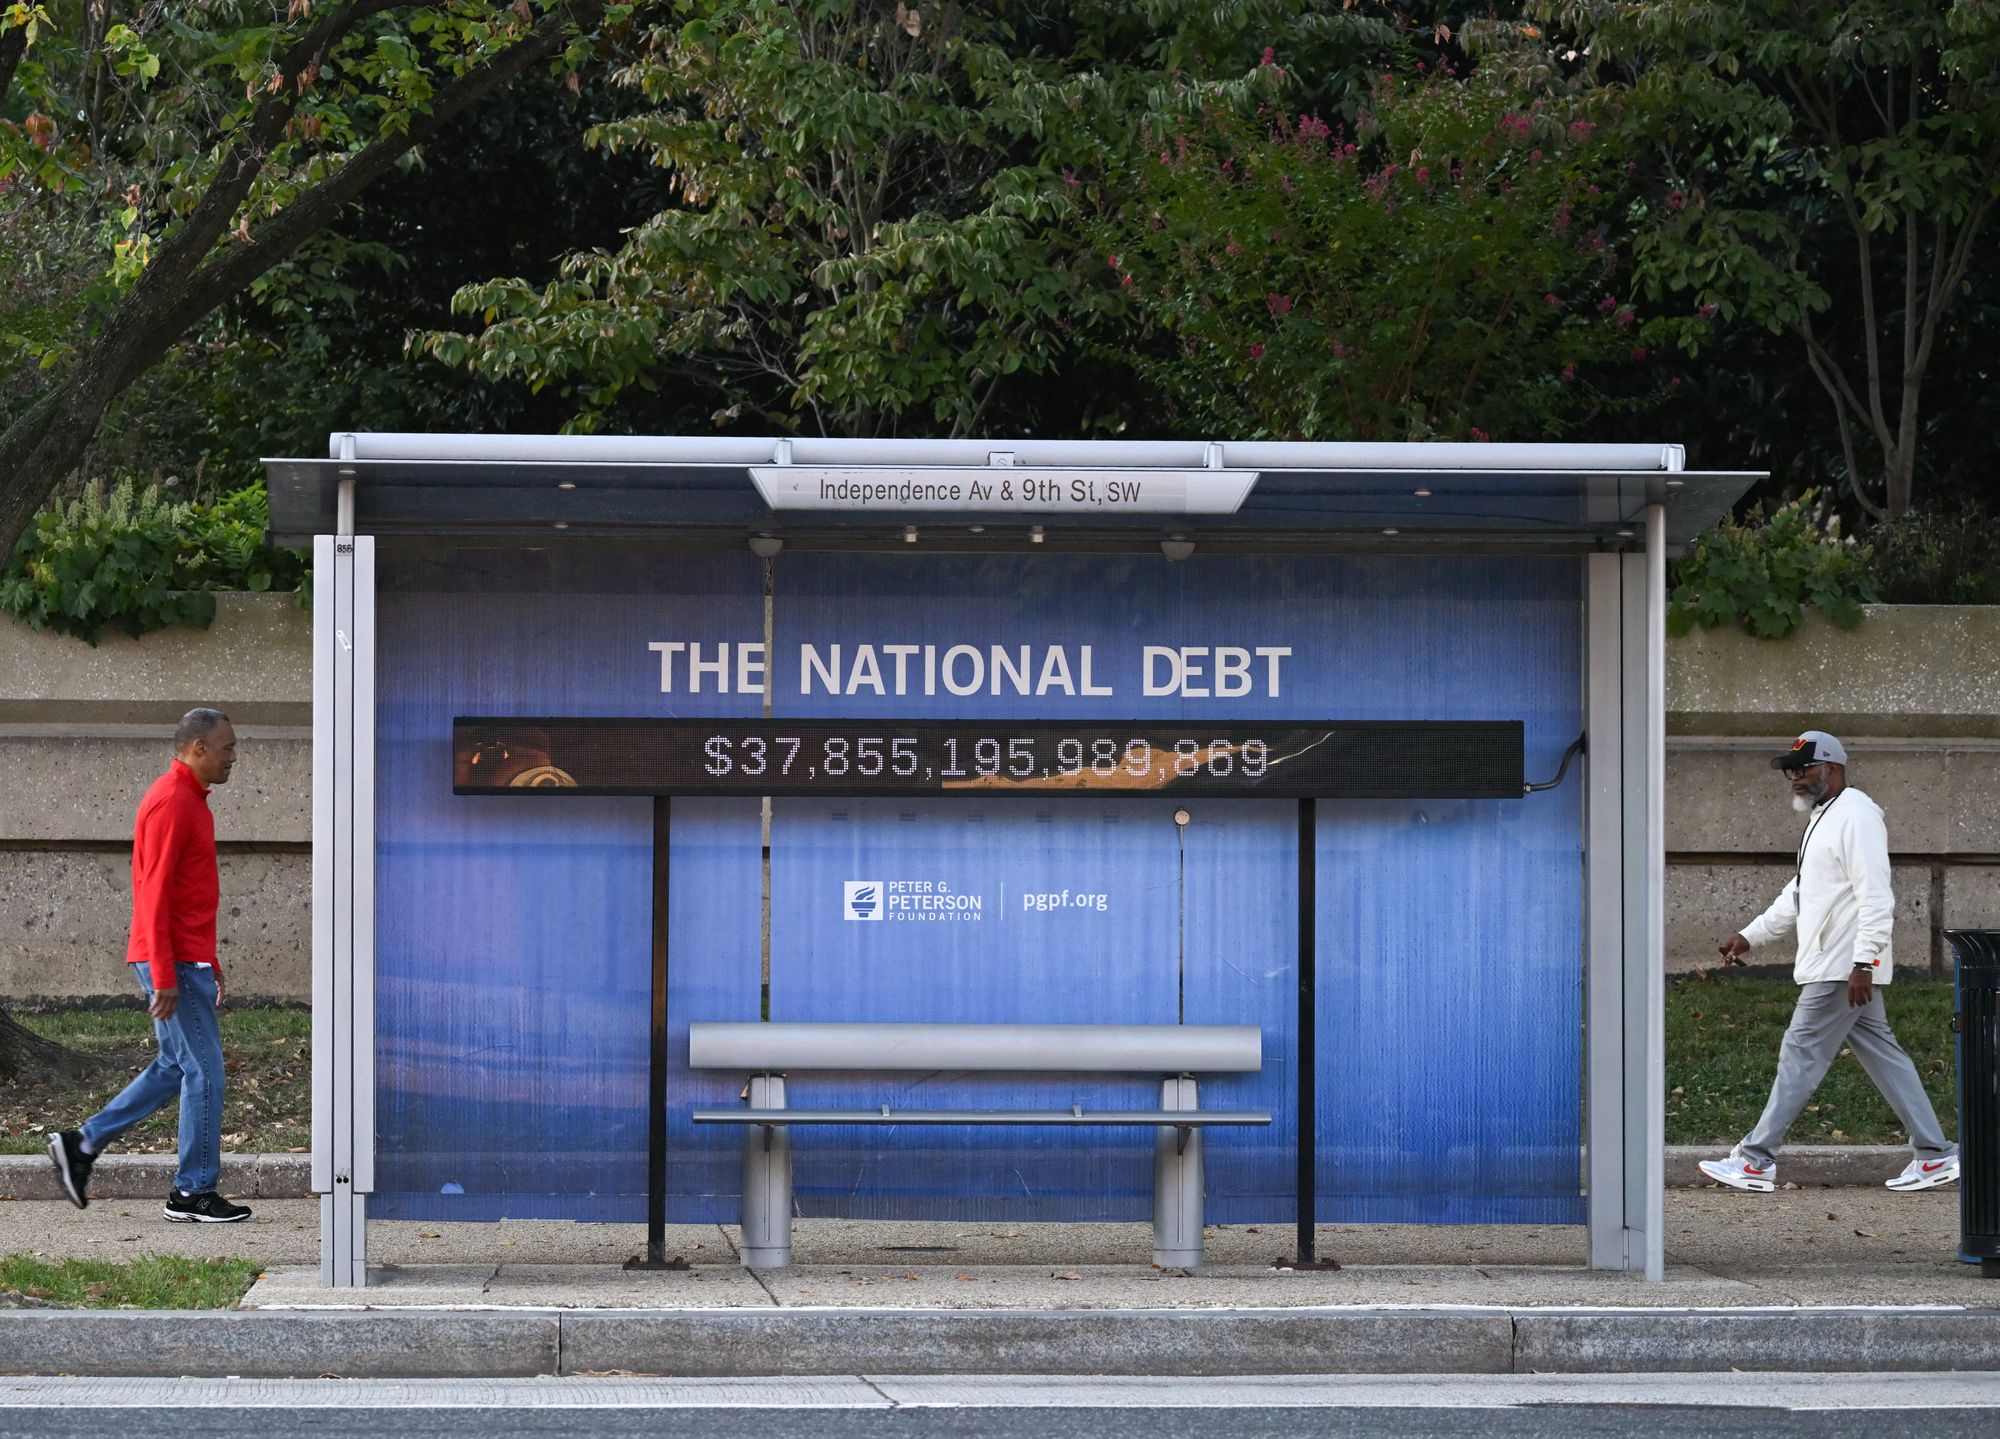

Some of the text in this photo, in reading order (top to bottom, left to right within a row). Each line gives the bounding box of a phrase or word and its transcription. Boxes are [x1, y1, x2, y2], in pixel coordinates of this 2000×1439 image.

[820, 479, 961, 505] Independence
[968, 480, 993, 501] Av
[1000, 480, 1014, 501] &
[1022, 478, 1061, 503] 9th
[1107, 481, 1141, 503] SW
[648, 641, 1293, 698] THE NATIONAL DEBT
[704, 735, 1269, 780] $37,855,195,989,869
[889, 881, 951, 893] PETER G.
[889, 895, 982, 910] PETERSON
[1023, 889, 1109, 912] pgpf.org
[888, 911, 981, 921] FOUNDATION
